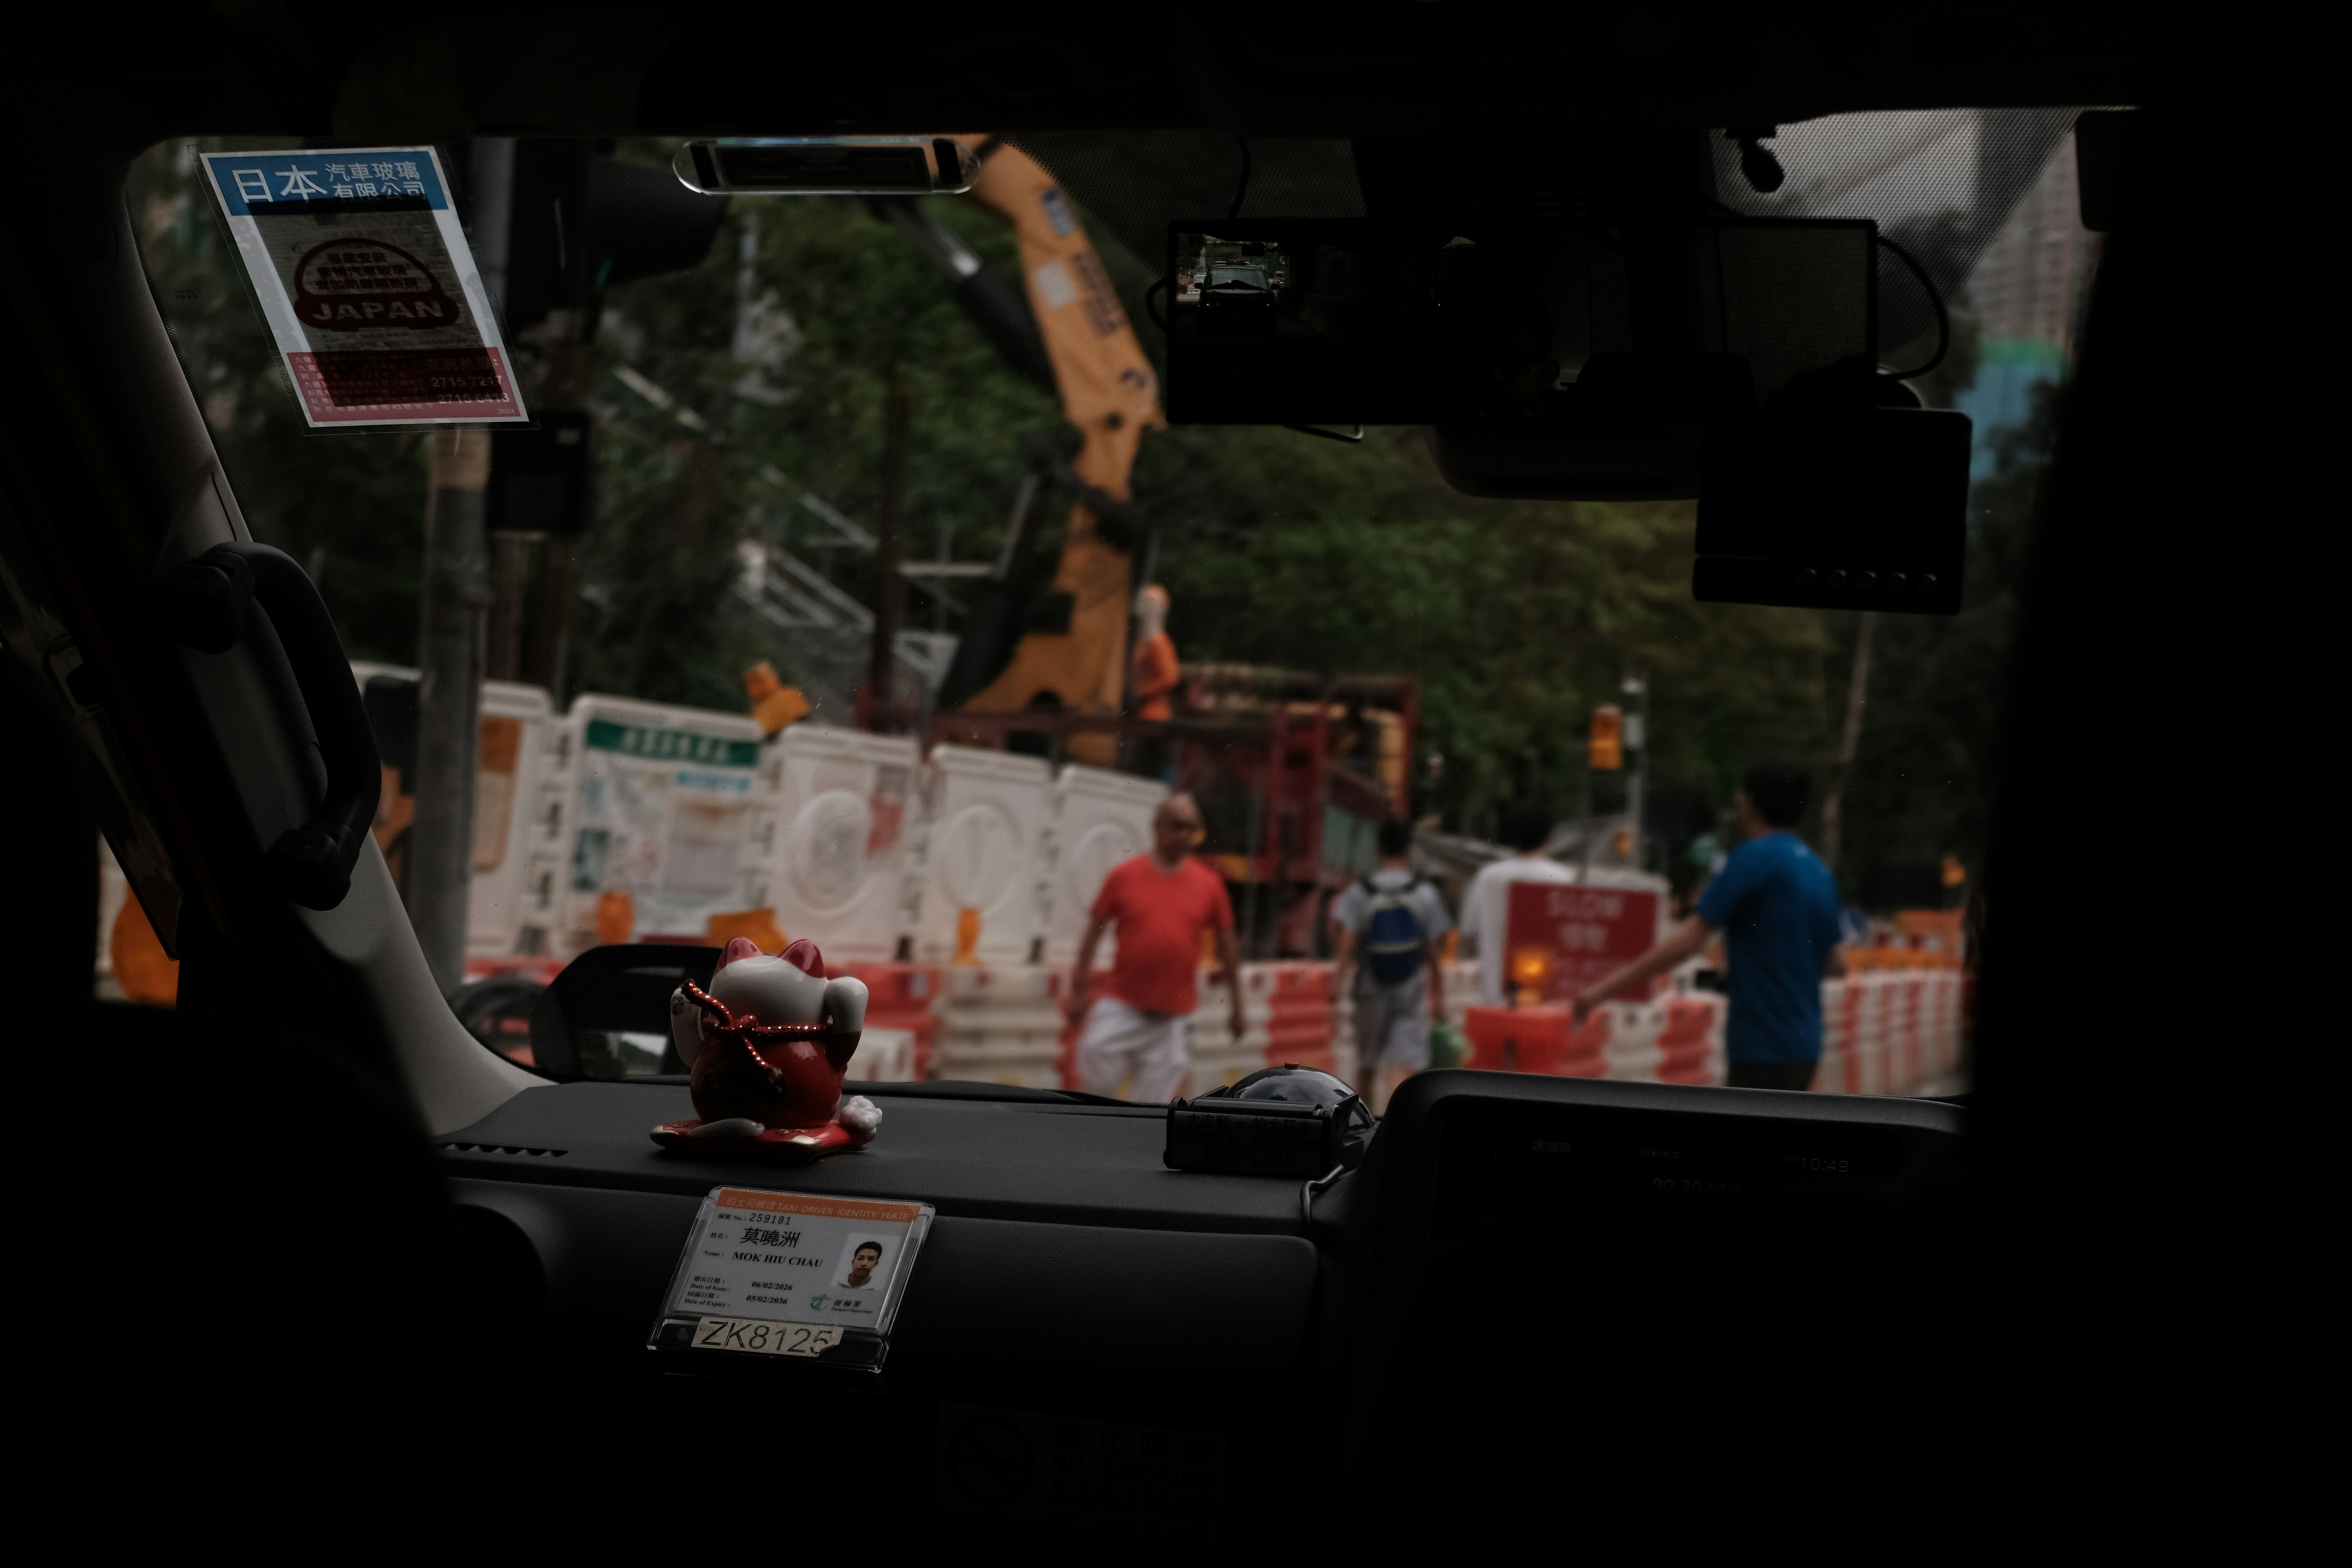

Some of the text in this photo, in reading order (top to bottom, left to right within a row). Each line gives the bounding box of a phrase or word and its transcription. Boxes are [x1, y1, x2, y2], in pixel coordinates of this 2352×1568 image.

[324, 160, 421, 182] 汽車玻璃
[231, 164, 328, 204] 日本
[332, 181, 426, 202] 有限公司
[311, 300, 444, 321] JAPAN
[431, 377, 466, 387] 2715
[468, 375, 502, 386] 7217
[437, 394, 472, 404] 2715
[1800, 1158, 1849, 1172] 10:49
[726, 1197, 909, 1221] 的士司機證 TAXI DRIVER IDENTITY PLATE
[749, 1213, 791, 1225] 259181
[739, 1227, 801, 1248] 莫曉洲
[732, 1252, 762, 1262] MOK
[764, 1254, 786, 1263] HIU
[788, 1257, 823, 1267] CHAU
[751, 1281, 793, 1291] 06/02/2026
[746, 1295, 788, 1305] 05/02/2036
[700, 1321, 832, 1355] ZK8125
[1054, 1420, 1215, 1467] 禁止吸煙
[1052, 1452, 1215, 1491] NO SMOKING
[1143, 1488, 1213, 1524] $5,000
